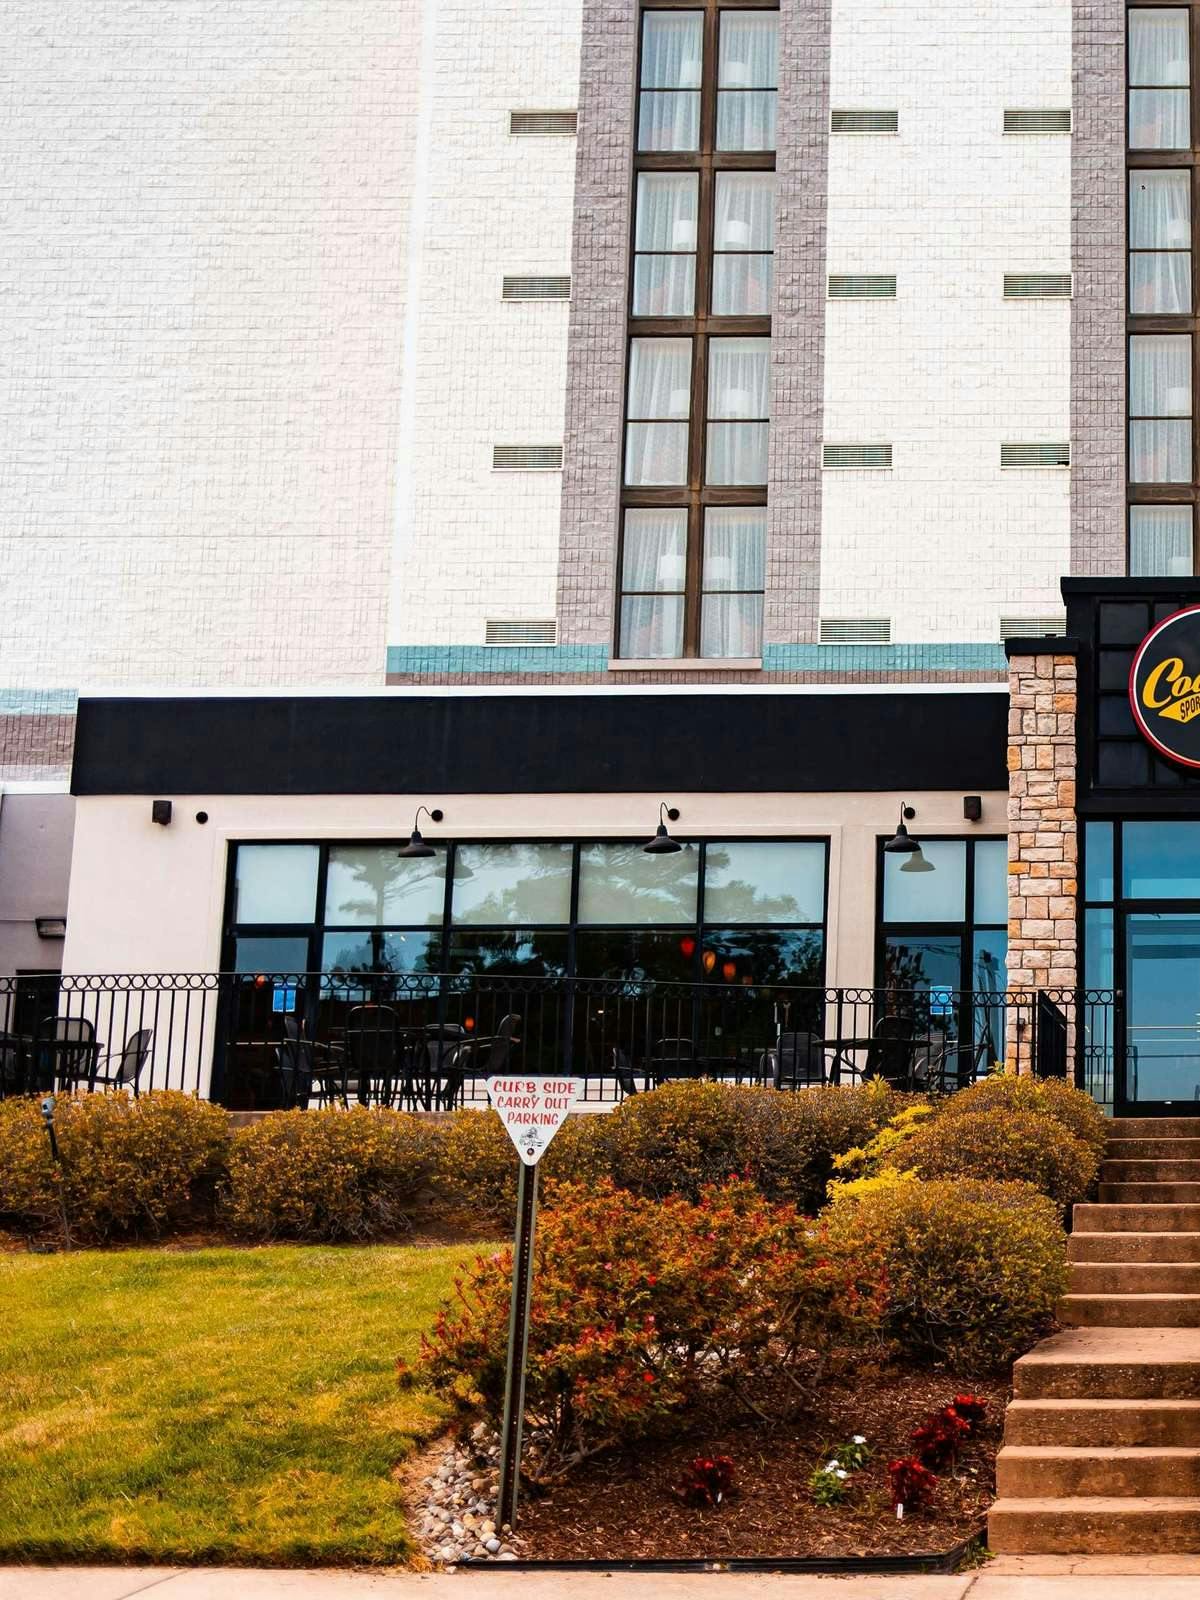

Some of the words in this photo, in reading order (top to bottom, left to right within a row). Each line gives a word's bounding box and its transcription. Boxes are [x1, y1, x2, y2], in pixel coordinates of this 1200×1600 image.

[493, 1081, 536, 1093] CURB
[543, 1082, 576, 1094] SIDE
[497, 1096, 540, 1109] CARRY
[544, 1097, 570, 1109] OUT
[507, 1112, 559, 1125] PARKING
